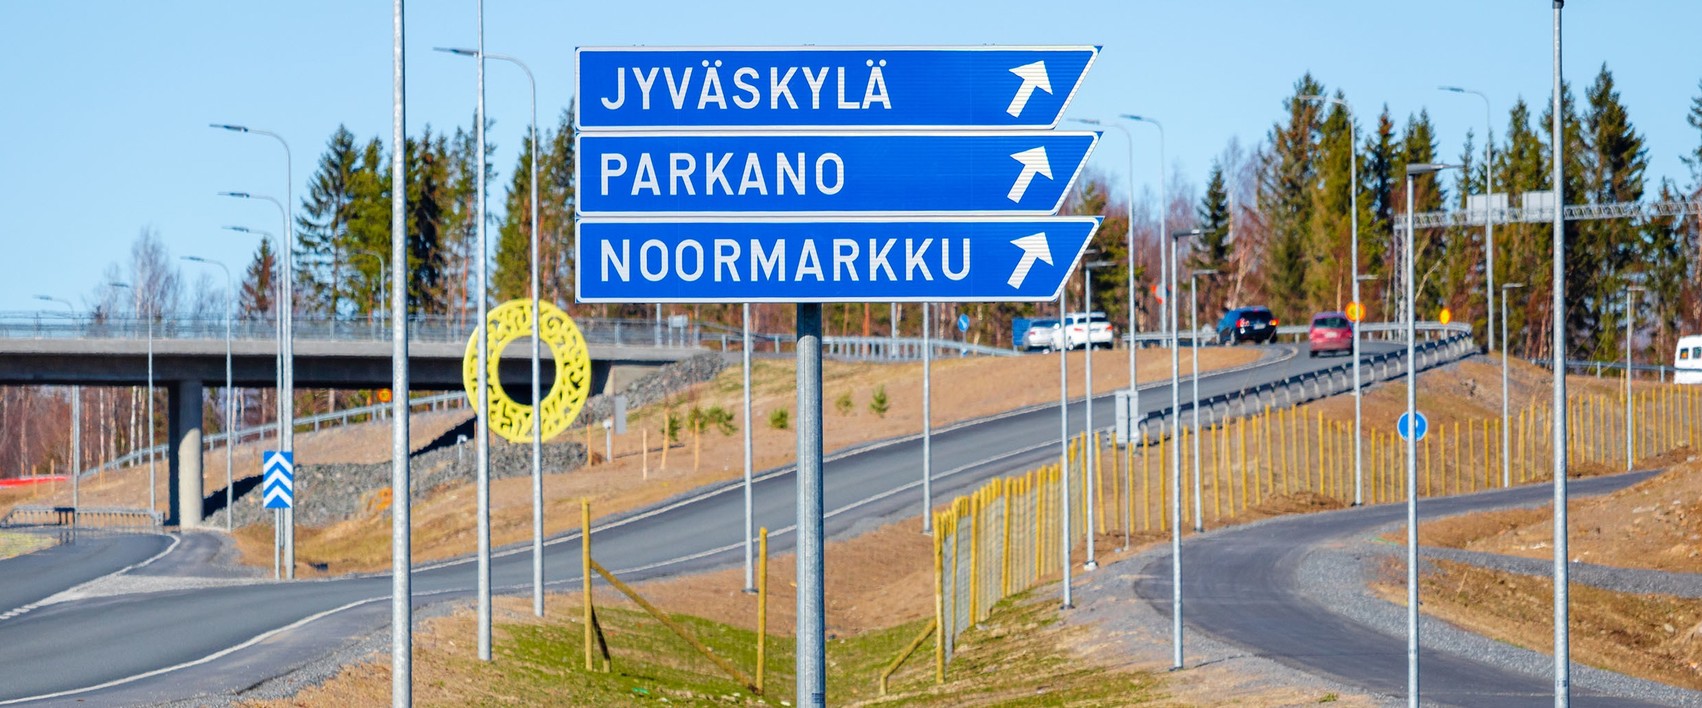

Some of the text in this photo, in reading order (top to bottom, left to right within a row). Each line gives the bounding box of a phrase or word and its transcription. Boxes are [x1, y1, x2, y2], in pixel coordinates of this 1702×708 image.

[601, 59, 892, 110] JYVÄSKYLÄ
[601, 152, 845, 196] PARKANO
[601, 238, 971, 282] NOORMARKKU
